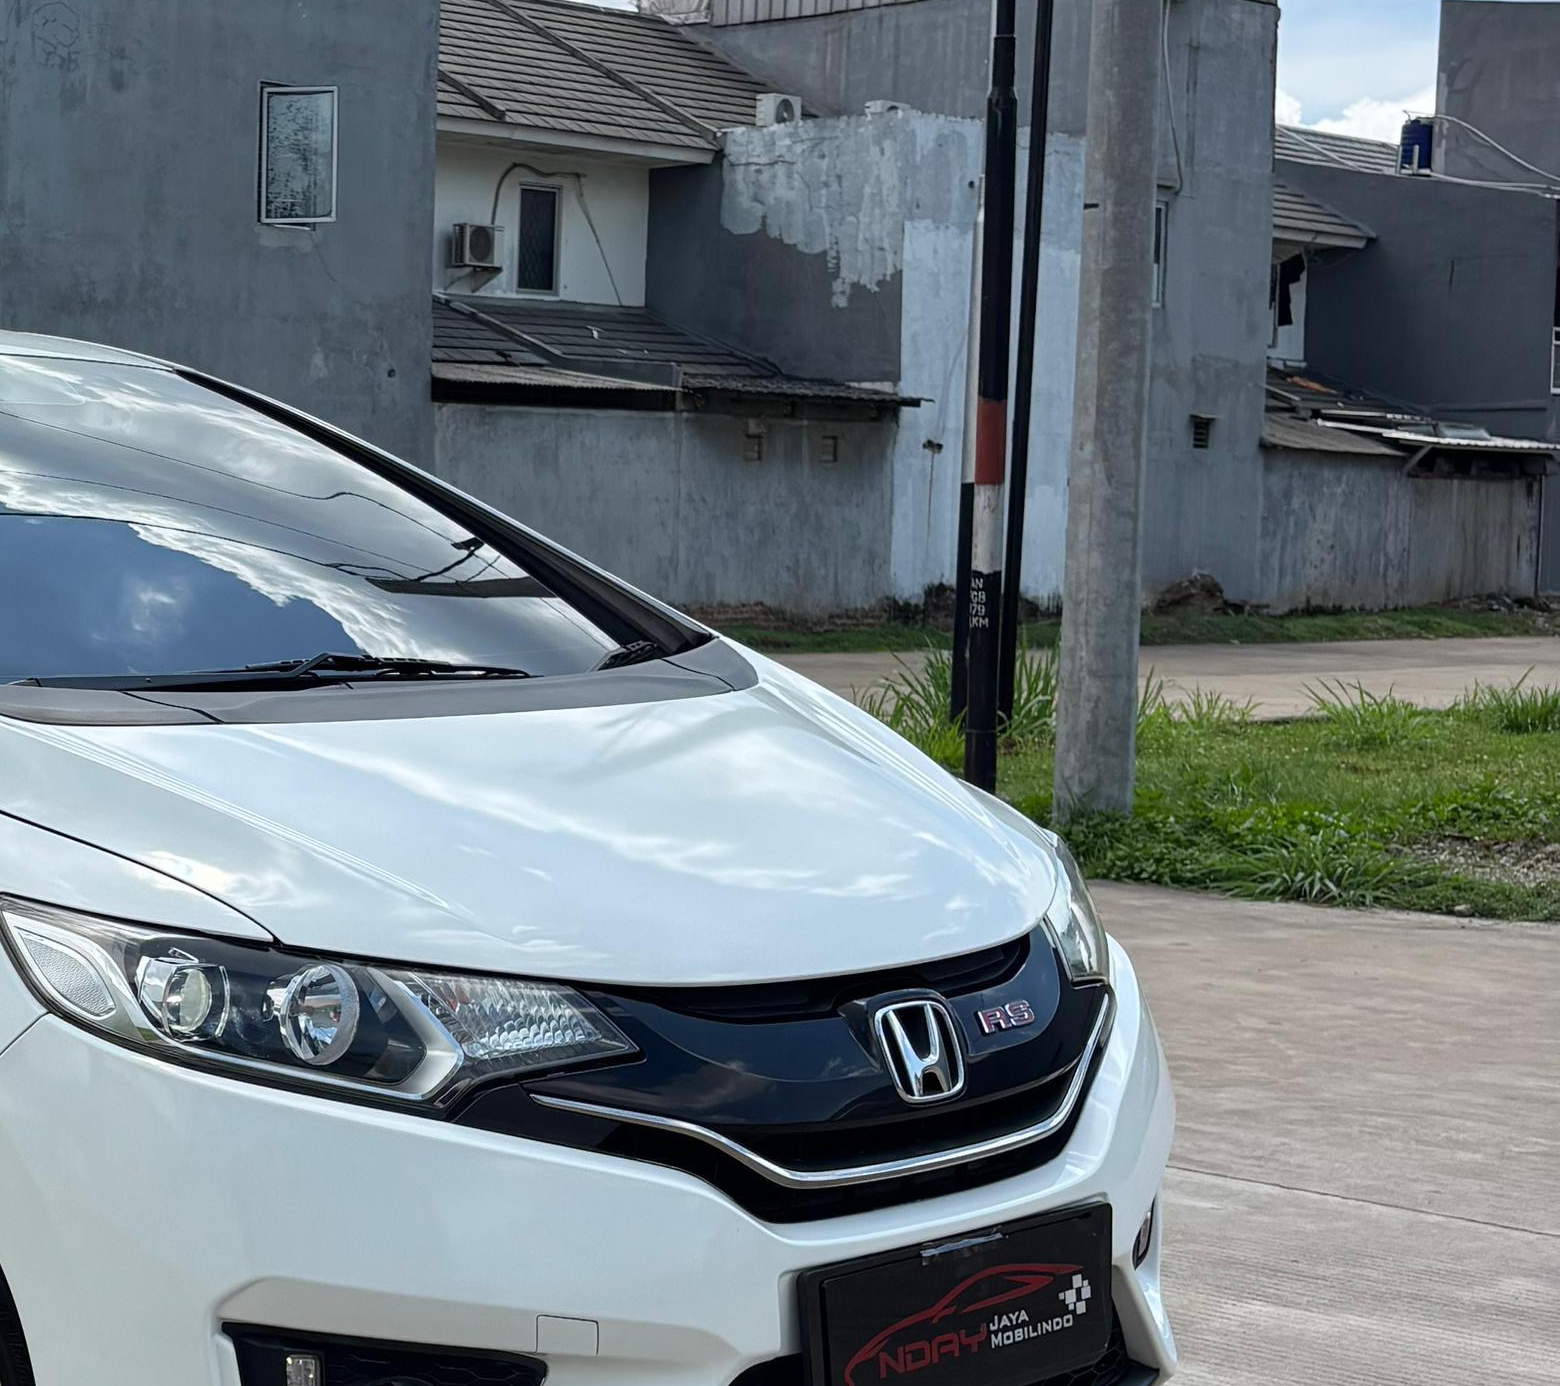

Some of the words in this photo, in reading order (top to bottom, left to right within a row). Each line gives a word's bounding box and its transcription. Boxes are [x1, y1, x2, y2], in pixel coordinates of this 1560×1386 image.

[977, 999, 1035, 1035] RS
[989, 1309, 1030, 1332] JAYA
[990, 1313, 1074, 1350] MOBILINDO
[878, 1322, 988, 1380] NDAY
